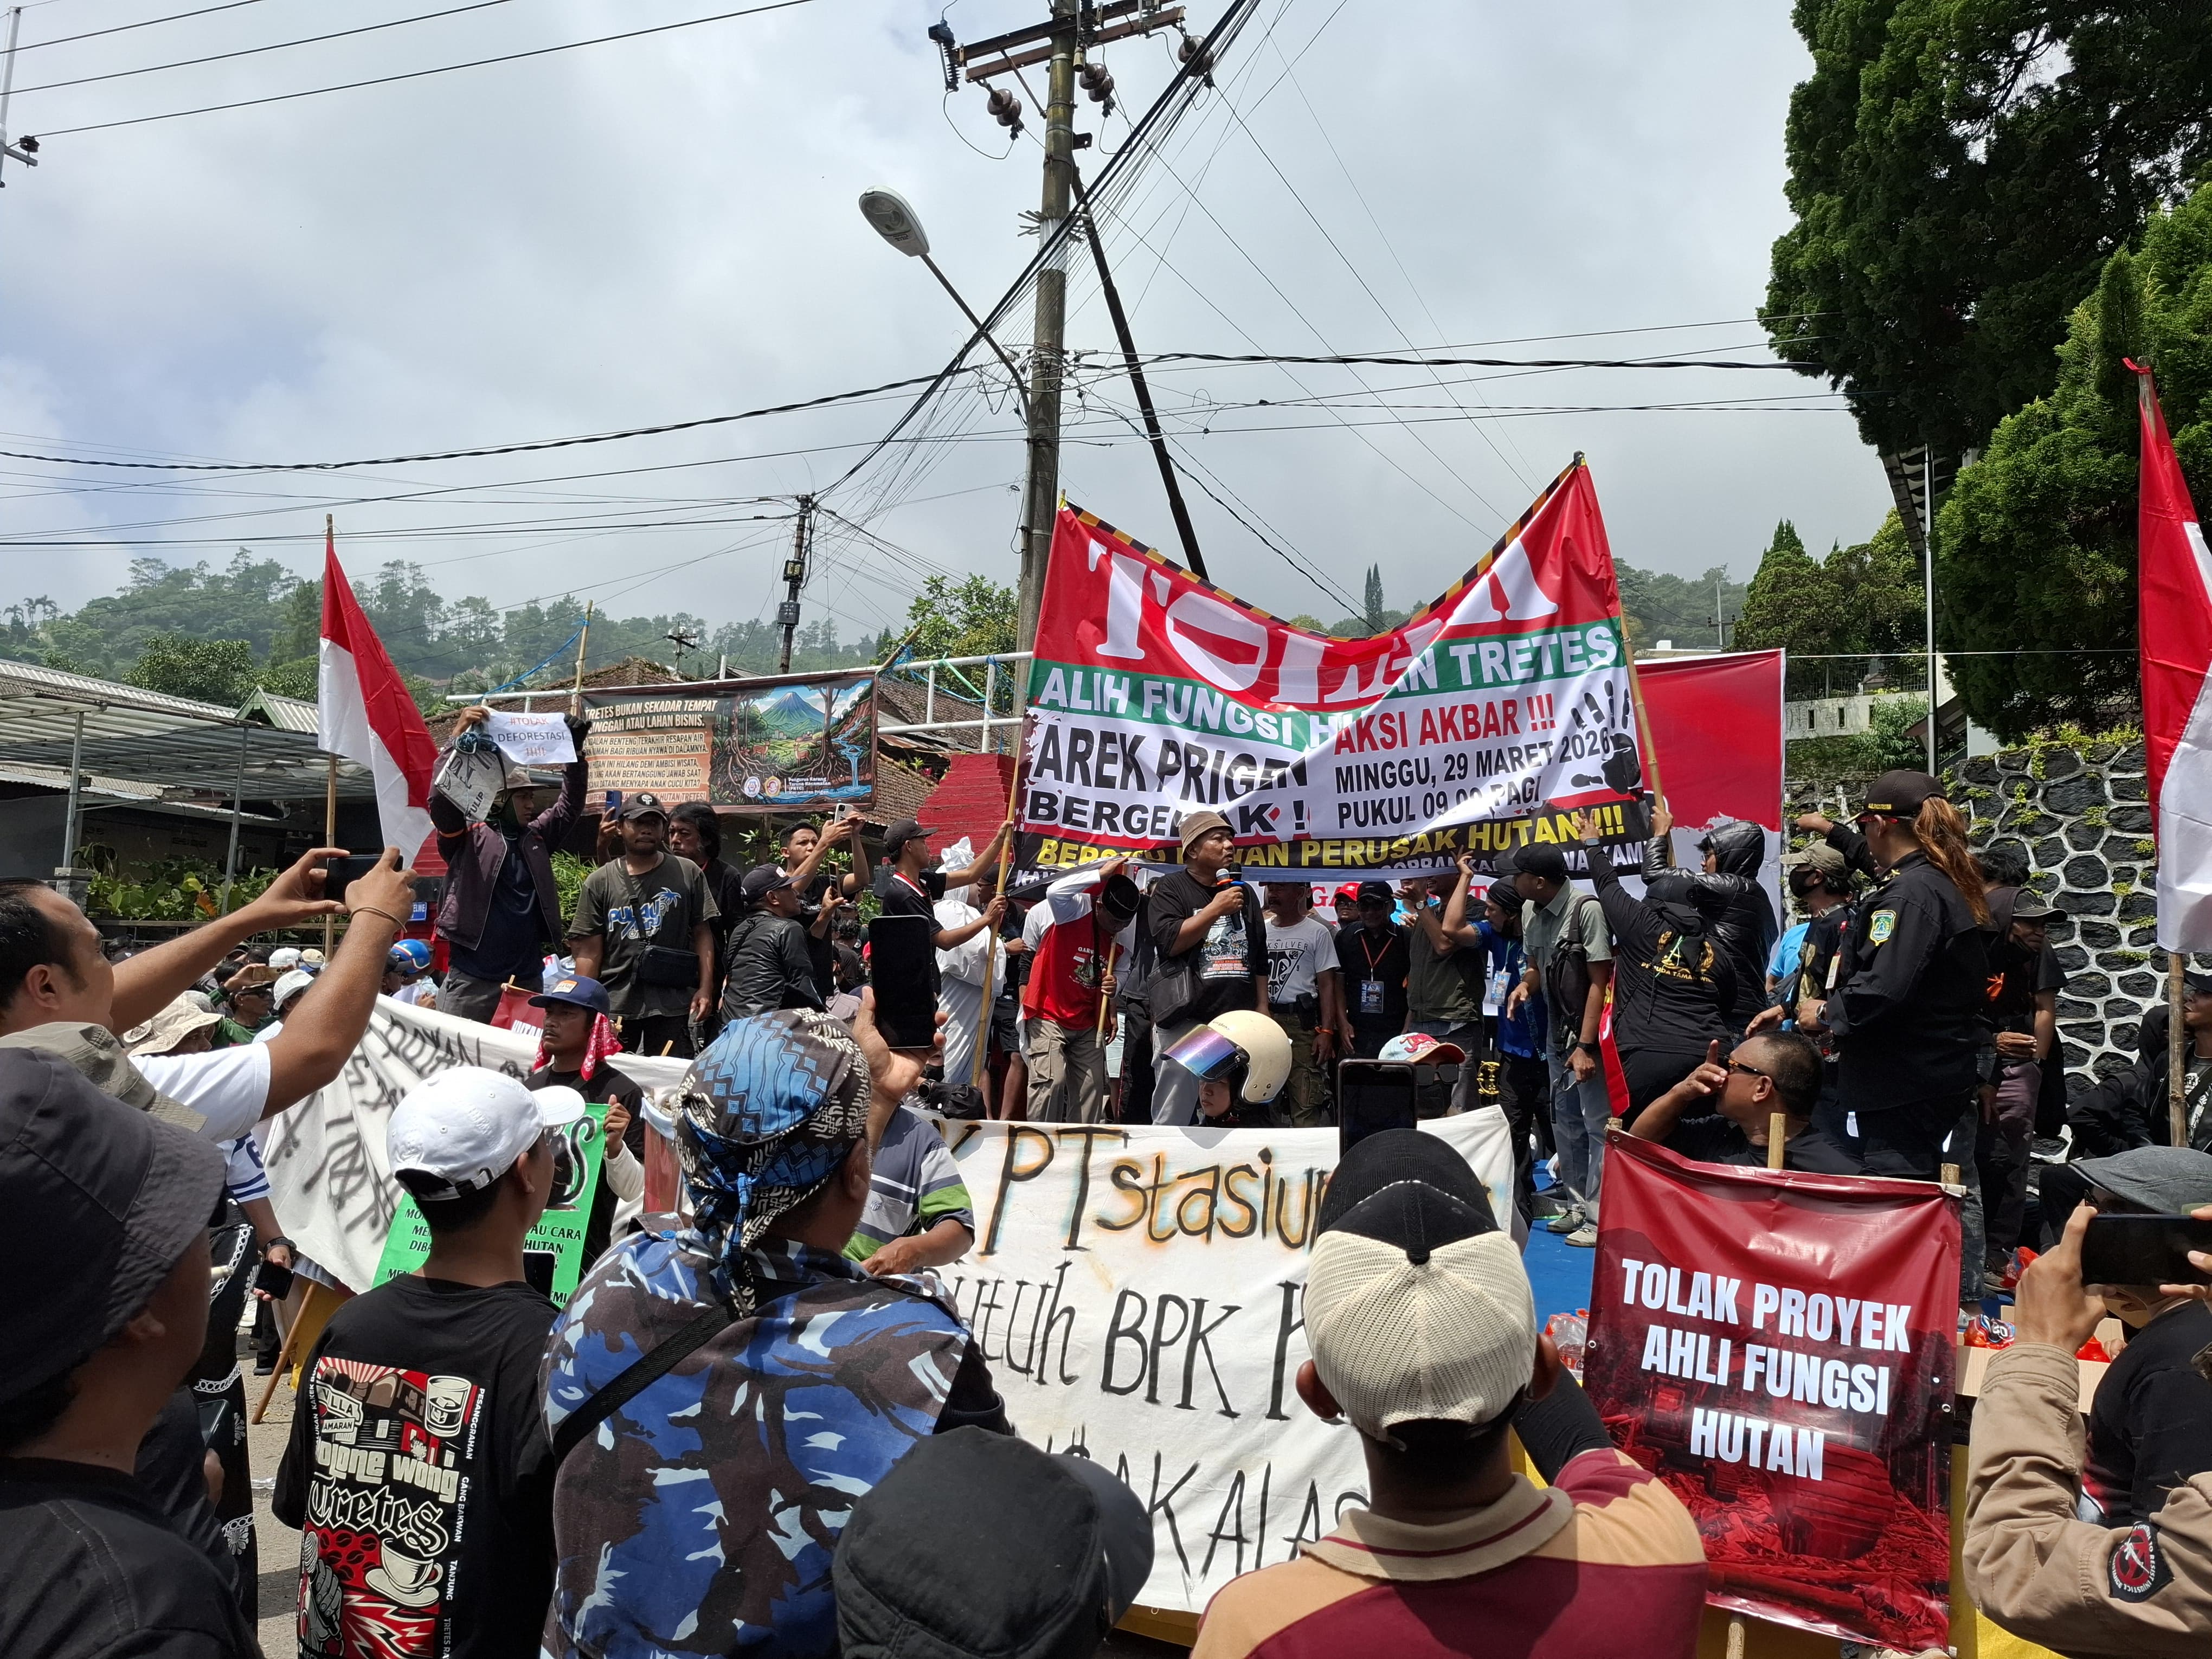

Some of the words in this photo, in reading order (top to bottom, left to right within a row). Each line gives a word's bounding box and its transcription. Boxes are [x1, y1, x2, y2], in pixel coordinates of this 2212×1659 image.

[1039, 667, 1129, 714] ALIH
[1142, 680, 1292, 746] FUNGSI
[1450, 626, 1618, 686] TRETES
[510, 717, 549, 726] #TOLAK
[585, 706, 614, 721] TRETES
[615, 702, 642, 717] BUKAN
[644, 700, 682, 713] SEKADAR
[683, 699, 718, 712] TEMPAT
[626, 717, 645, 730] ATAU
[647, 715, 674, 728] LAHAN
[676, 713, 705, 728] BISNIS.
[1334, 711, 1409, 755] AKSI
[1419, 699, 1520, 746] AKBAR
[1526, 693, 1557, 731] !!!
[497, 732, 565, 742] DEFORESTASI
[609, 737, 637, 746] BENTENG
[638, 735, 665, 745] TERAKHIR
[666, 734, 692, 743] RESAPAN
[694, 733, 704, 742] AIR
[610, 747, 625, 755] BAGI
[626, 747, 647, 755] RIBUAN
[649, 745, 667, 755] NYAWA
[669, 745, 674, 754] DI
[676, 744, 708, 753] DALAMNYA.
[622, 770, 666, 778] BERTANGGUNG
[666, 769, 686, 778] JAWAB
[686, 769, 702, 777] SAAT
[640, 760, 655, 768] DEMI
[655, 760, 676, 768] AMBISI
[677, 759, 699, 768] WISATA,
[1033, 724, 1147, 792] AREK
[1335, 757, 1436, 794] MINGGU,
[1443, 752, 1468, 783] 29
[1476, 741, 1554, 778] MARET
[1558, 726, 1610, 763] 2026
[620, 780, 648, 788] MENYAPA
[651, 780, 666, 788] ANAK
[684, 779, 700, 787] KITA?
[660, 793, 680, 801] HUTAN
[1338, 795, 1417, 829] PUKUL
[1490, 776, 1541, 809] PAGI
[1301, 828, 1459, 866] PERUSAK
[1468, 812, 1580, 851] HUTAN
[550, 1226, 582, 1240] CARA
[1622, 1258, 1741, 1325] TOLAK
[1752, 1283, 1912, 1353] PROYEK
[1101, 1288, 1243, 1419] BPK
[1641, 1324, 1732, 1386] AHLI
[1742, 1343, 1889, 1416] FUNGSI
[465, 1387, 486, 1460] PESANGGRAHAN
[1690, 1407, 1825, 1481] HUTAN
[393, 1454, 459, 1503] wong
[459, 1476, 470, 1503] GANG
[308, 1471, 449, 1558] Tretes
[454, 1503, 465, 1543] BAKWAN
[446, 1560, 458, 1601] TANJUNG
[443, 1618, 452, 1644] TRETES
